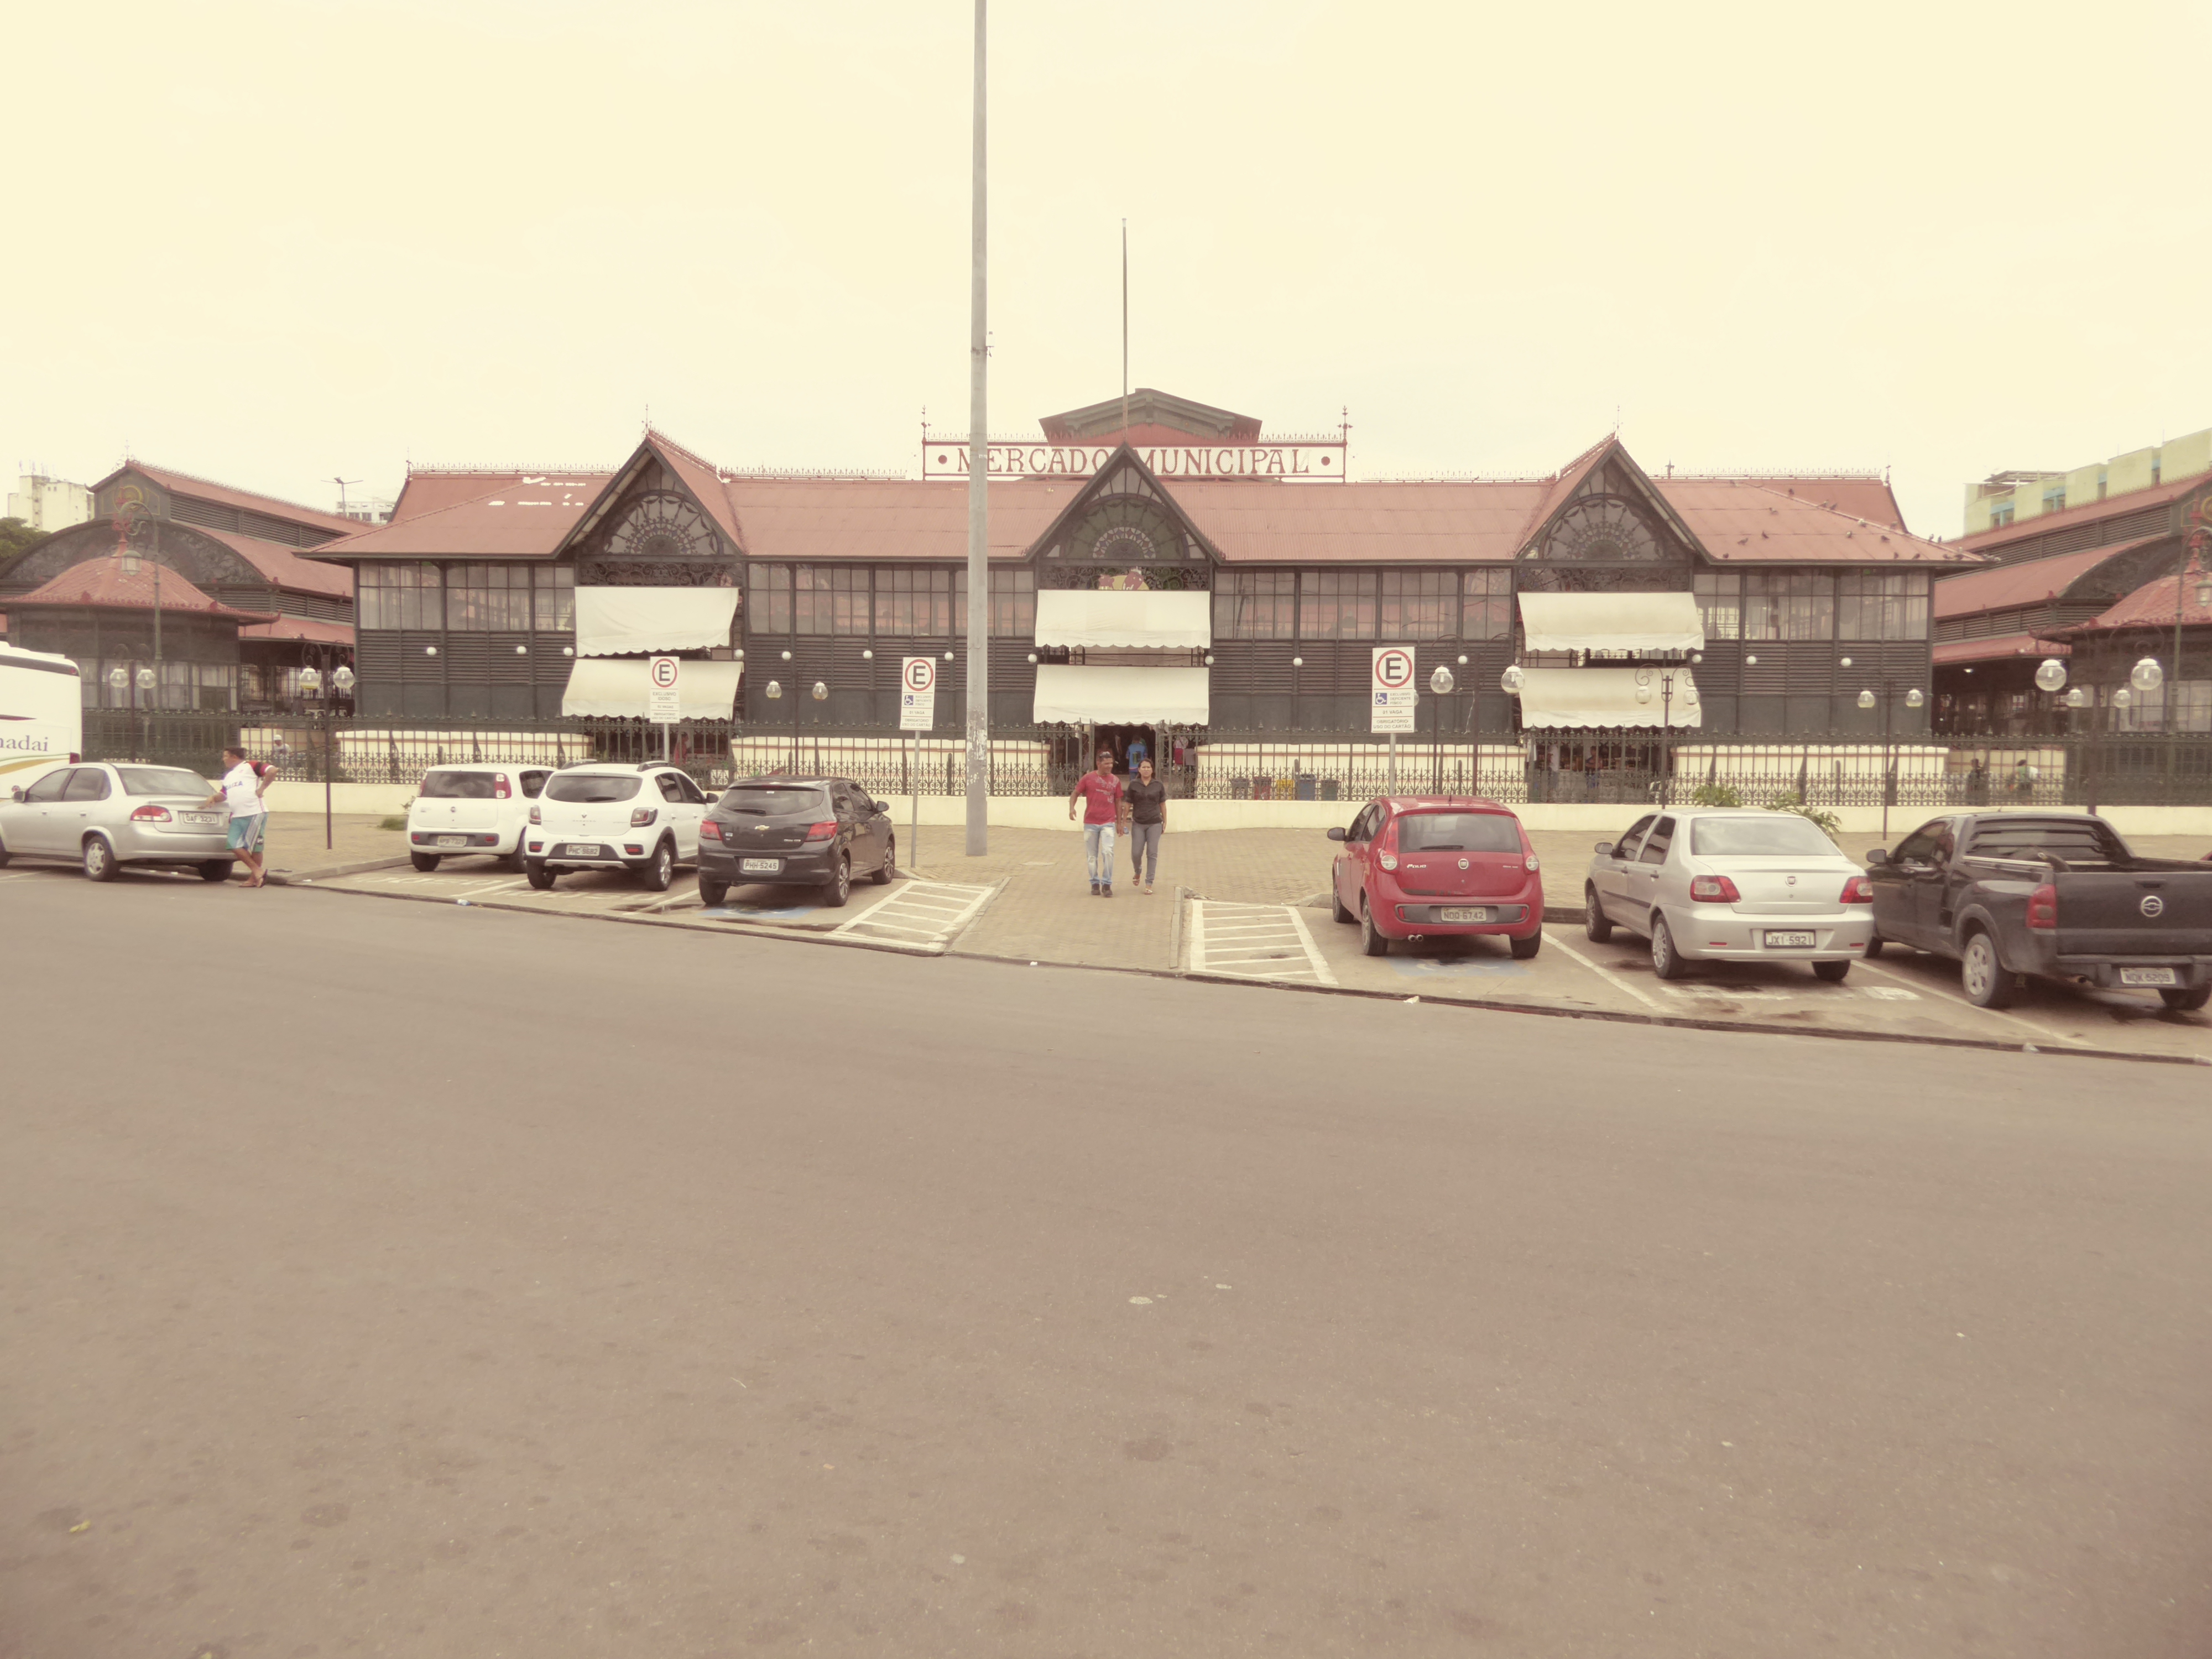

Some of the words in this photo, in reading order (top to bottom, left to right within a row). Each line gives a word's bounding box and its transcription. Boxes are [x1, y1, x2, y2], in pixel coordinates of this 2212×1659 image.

[659, 664, 670, 681] E
[912, 665, 926, 685] E
[1385, 657, 1402, 680] E
